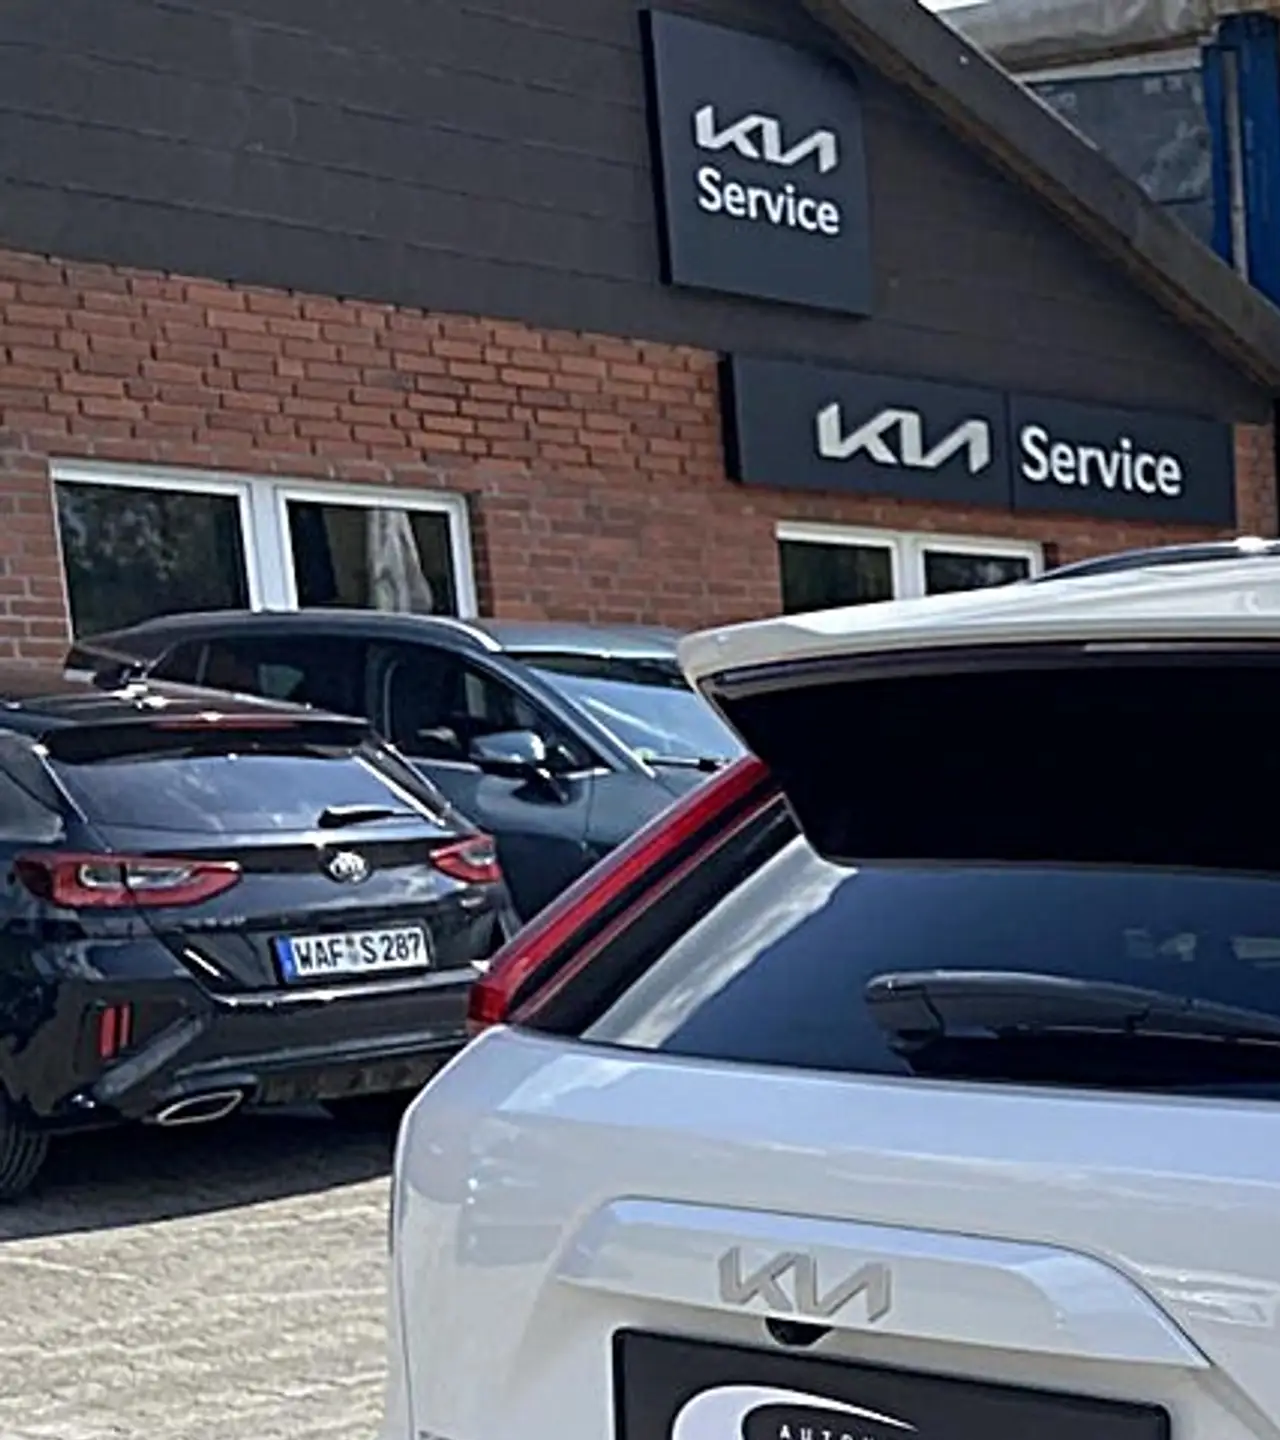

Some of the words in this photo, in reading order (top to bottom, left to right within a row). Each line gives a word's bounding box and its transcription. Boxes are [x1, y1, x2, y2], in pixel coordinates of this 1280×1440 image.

[698, 167, 840, 236] Service
[1020, 425, 1181, 497] Service
[295, 938, 342, 969] WAF
